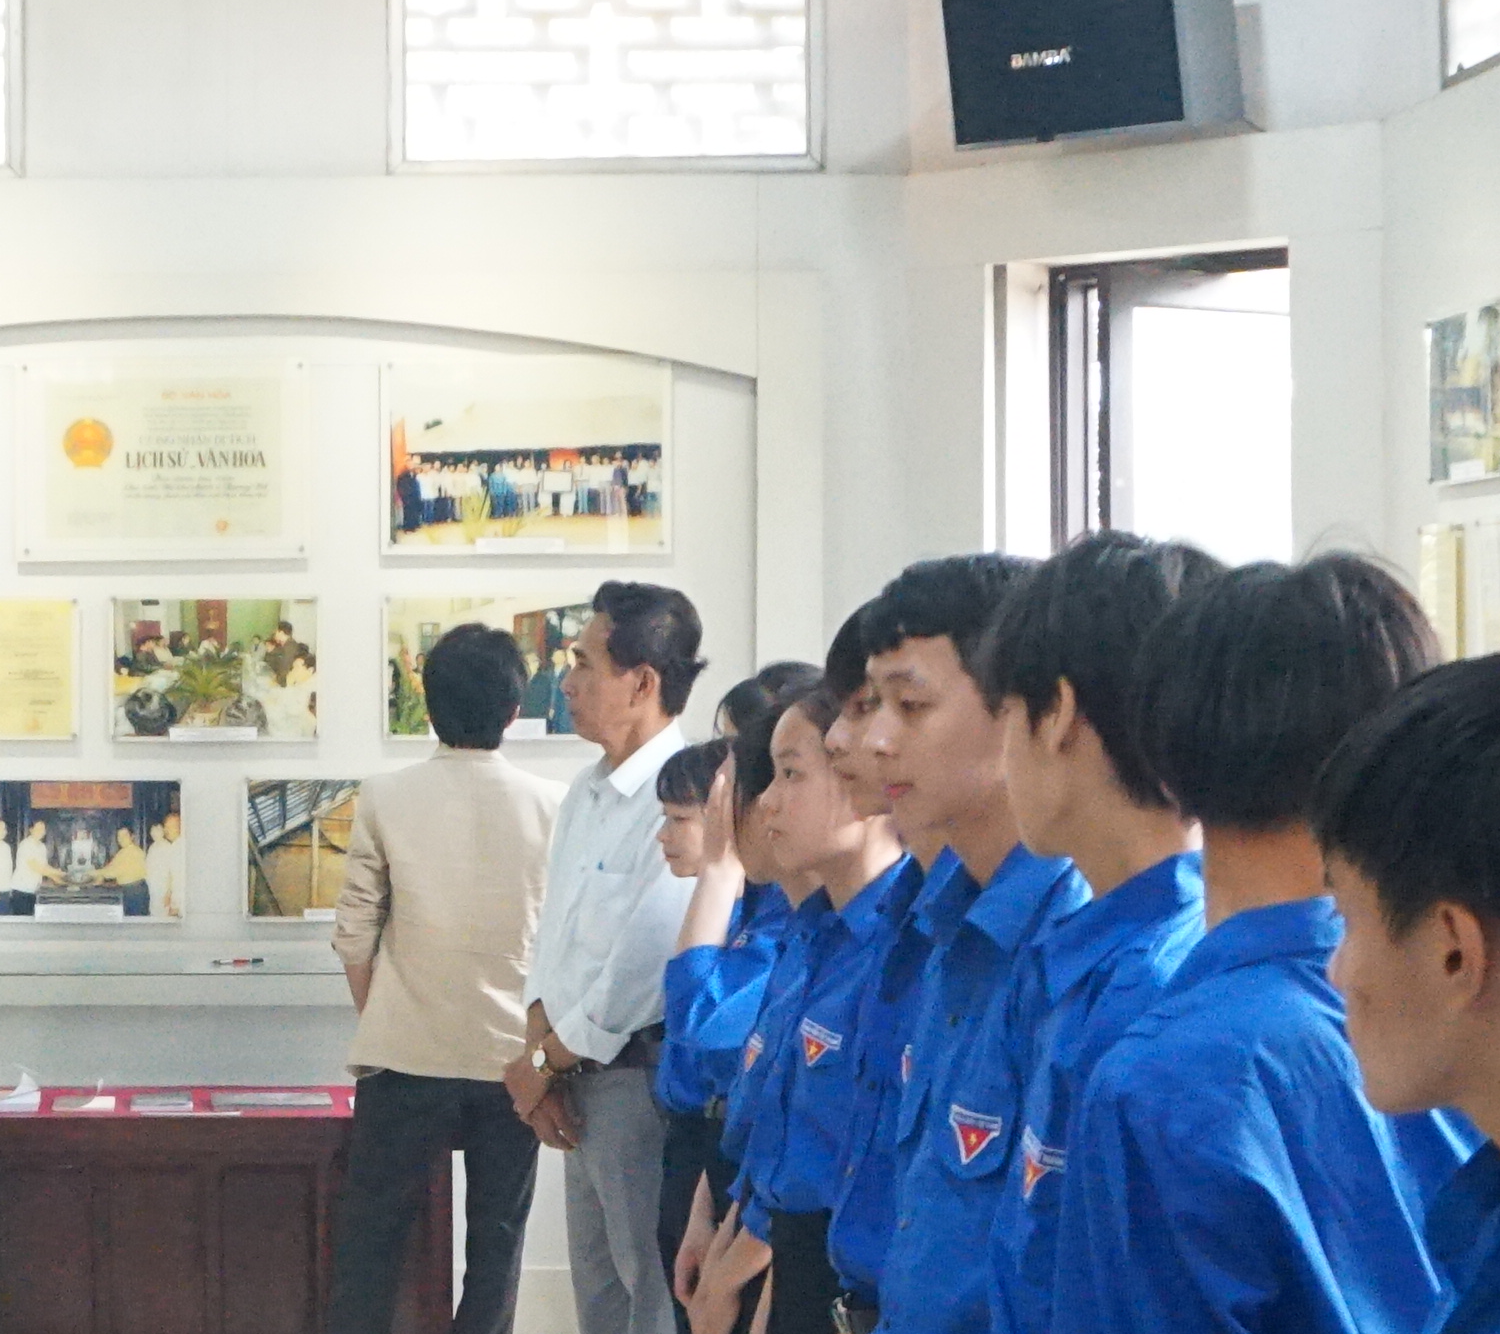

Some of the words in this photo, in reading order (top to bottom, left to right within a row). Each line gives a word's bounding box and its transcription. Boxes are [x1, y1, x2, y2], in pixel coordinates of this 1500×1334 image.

[125, 450, 164, 470] LỊCH
[167, 448, 189, 467] SỬ
[198, 448, 230, 467] VĂN
